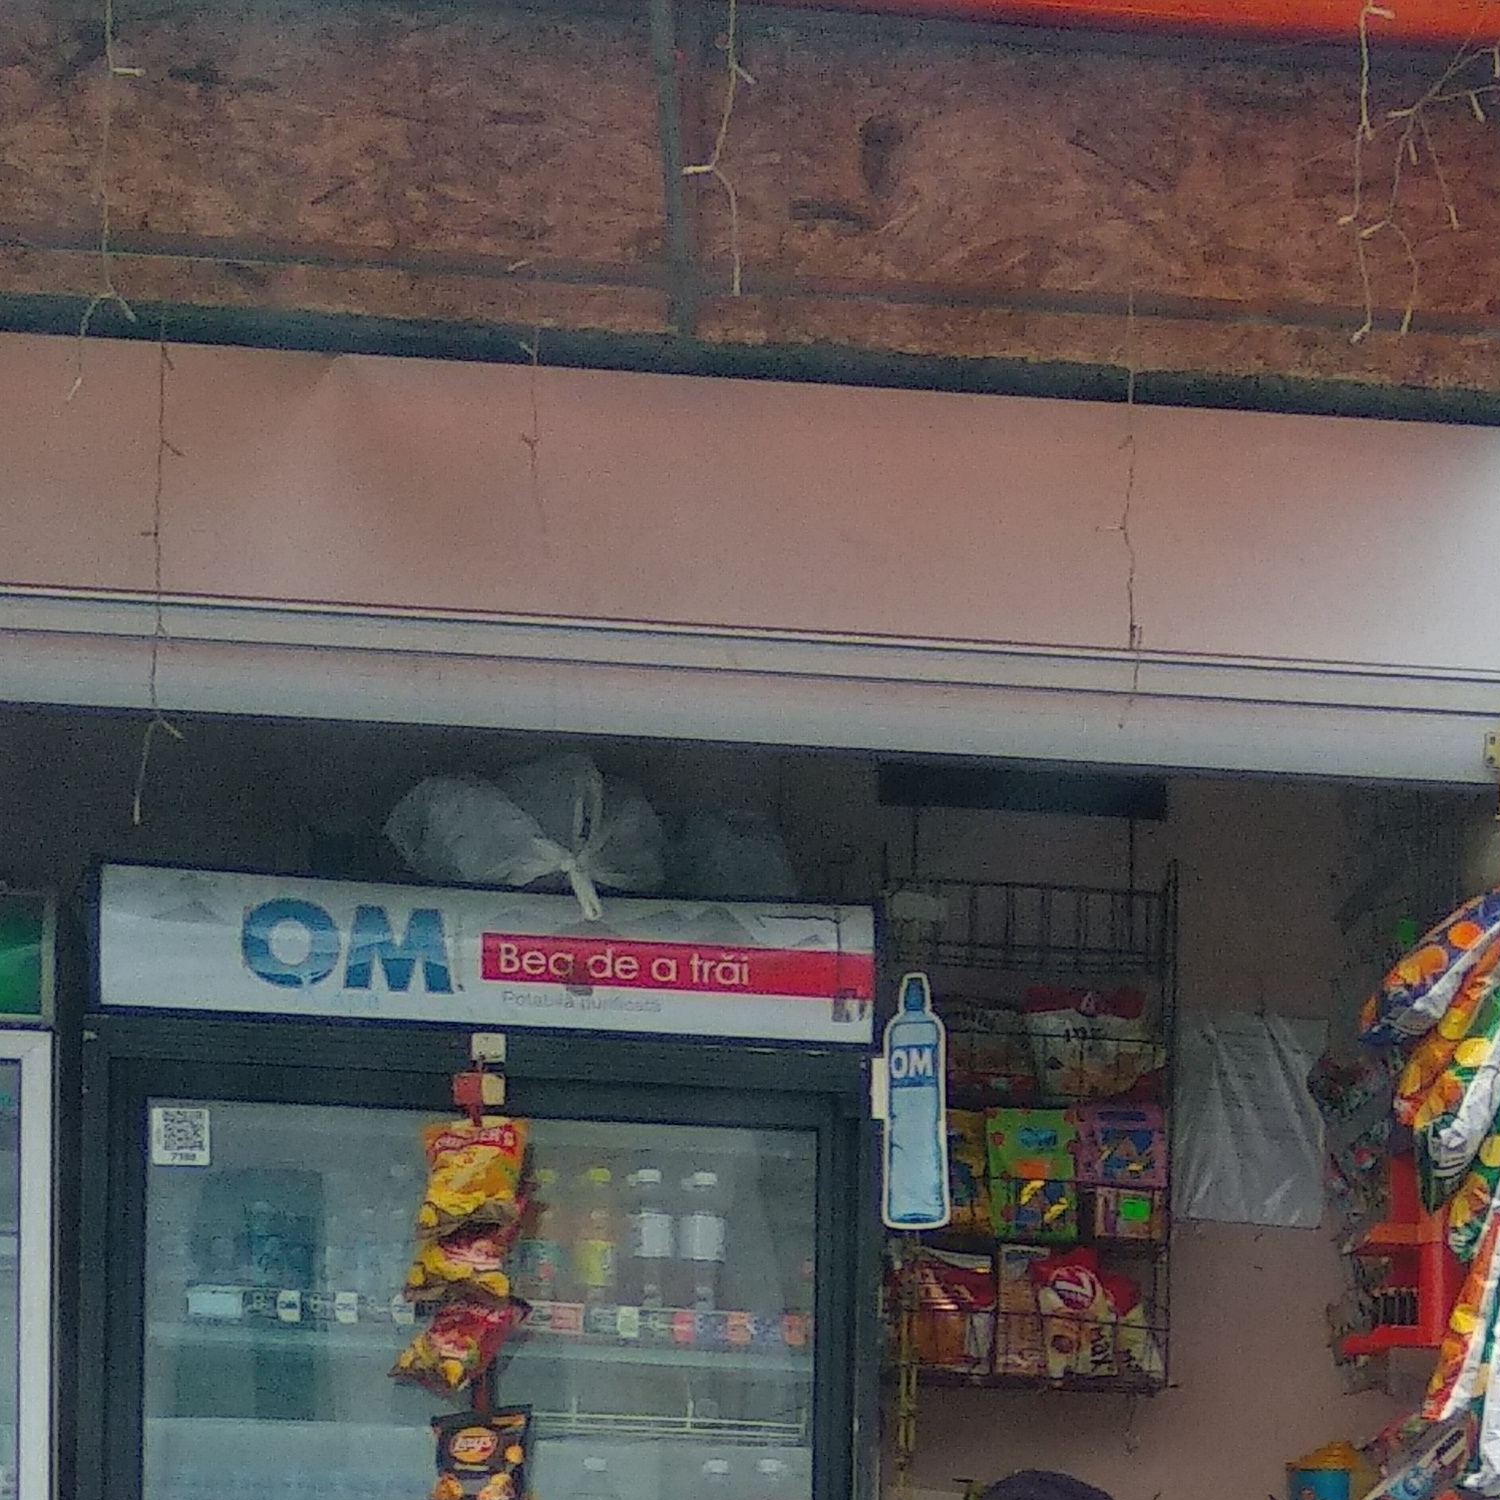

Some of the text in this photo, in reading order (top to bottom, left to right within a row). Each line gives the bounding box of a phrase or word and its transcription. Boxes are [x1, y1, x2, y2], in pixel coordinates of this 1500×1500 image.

[242, 897, 454, 994] OM
[588, 947, 638, 981] de
[651, 956, 677, 981] a
[689, 953, 750, 987] trăi
[891, 1048, 933, 1079] OM
